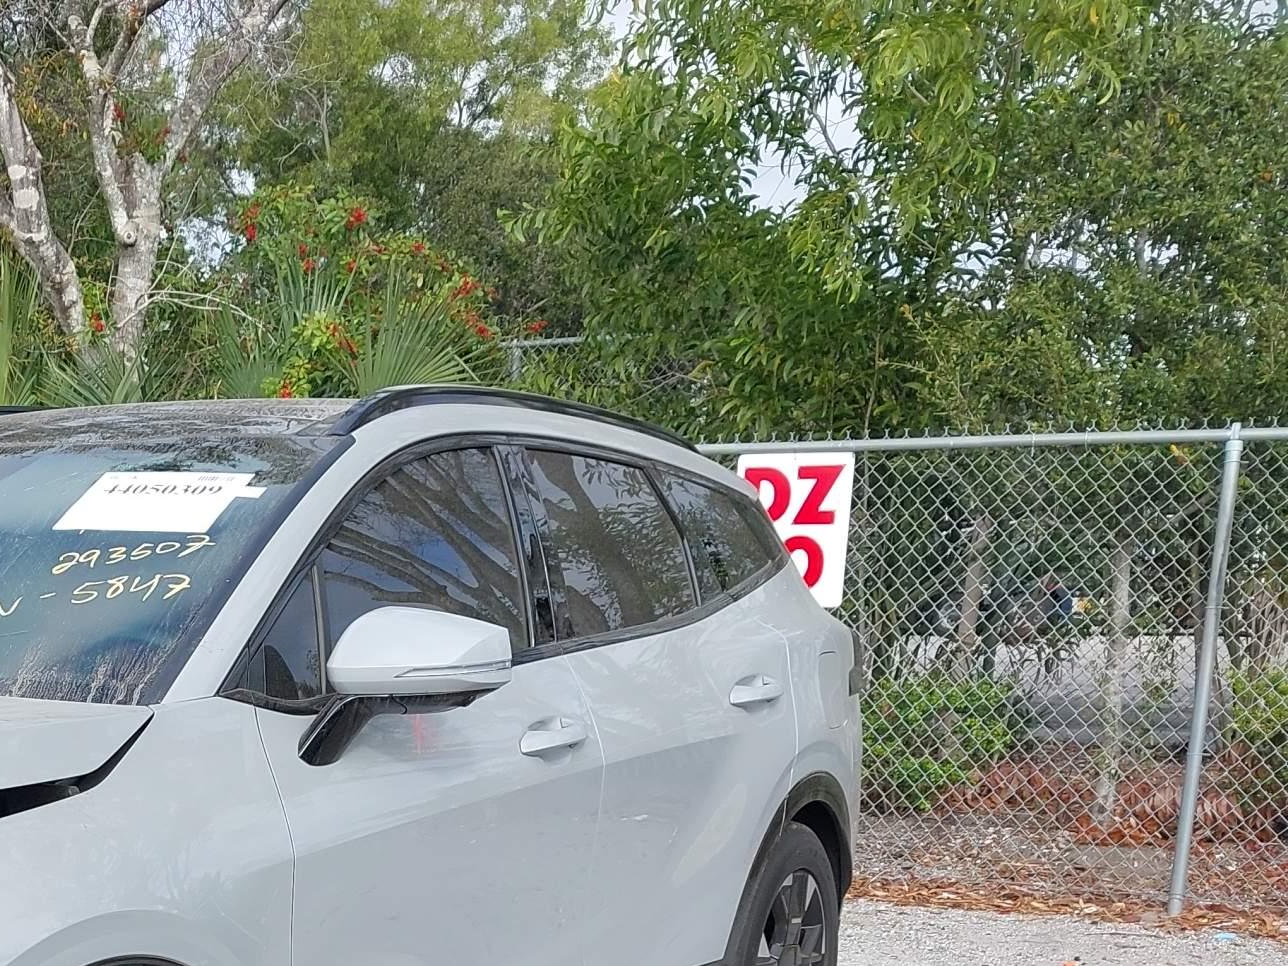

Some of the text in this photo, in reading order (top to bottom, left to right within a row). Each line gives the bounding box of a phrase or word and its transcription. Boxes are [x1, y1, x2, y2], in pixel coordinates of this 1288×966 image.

[104, 484, 224, 496] 44050309
[51, 534, 216, 575] 293507
[70, 574, 191, 604] 5847
